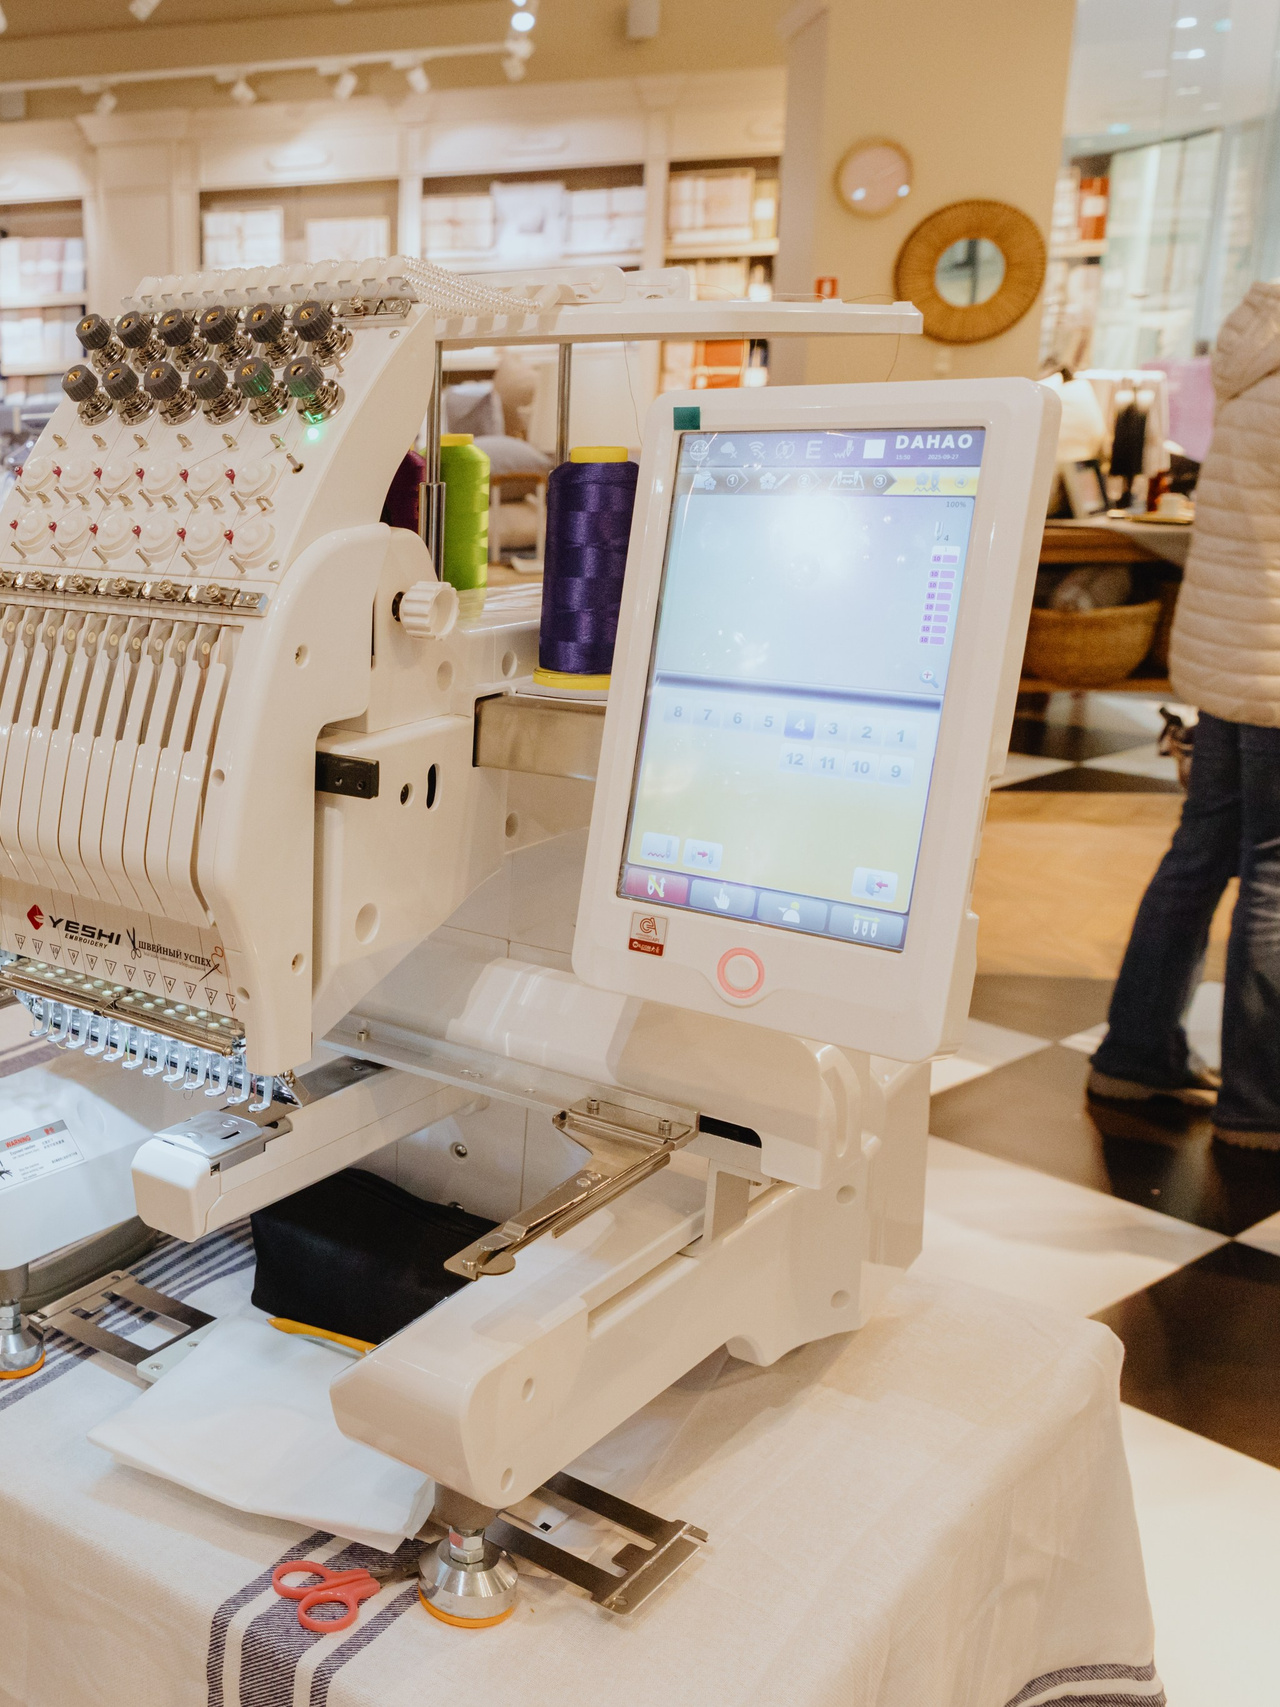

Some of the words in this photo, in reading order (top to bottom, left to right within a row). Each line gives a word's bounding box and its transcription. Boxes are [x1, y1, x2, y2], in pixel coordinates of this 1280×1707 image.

[895, 433, 973, 449] DAHAO
[674, 706, 683, 718] 8
[703, 708, 713, 721] 7
[733, 712, 742, 724] 6
[764, 715, 774, 728] 5
[794, 718, 806, 732] 4
[828, 722, 838, 735] 3
[861, 726, 872, 739] 2
[896, 730, 906, 743] 1
[786, 752, 804, 766] 12
[820, 756, 836, 770] 11
[852, 760, 870, 774] 10
[890, 764, 902, 778] 9
[49, 915, 121, 945] YESHI
[64, 932, 108, 949] EMBROIDERY
[138, 941, 182, 960] ШВЕЙНЫЙ
[184, 952, 212, 968] УСПЕХ
[5, 1135, 31, 1148] WARNING
